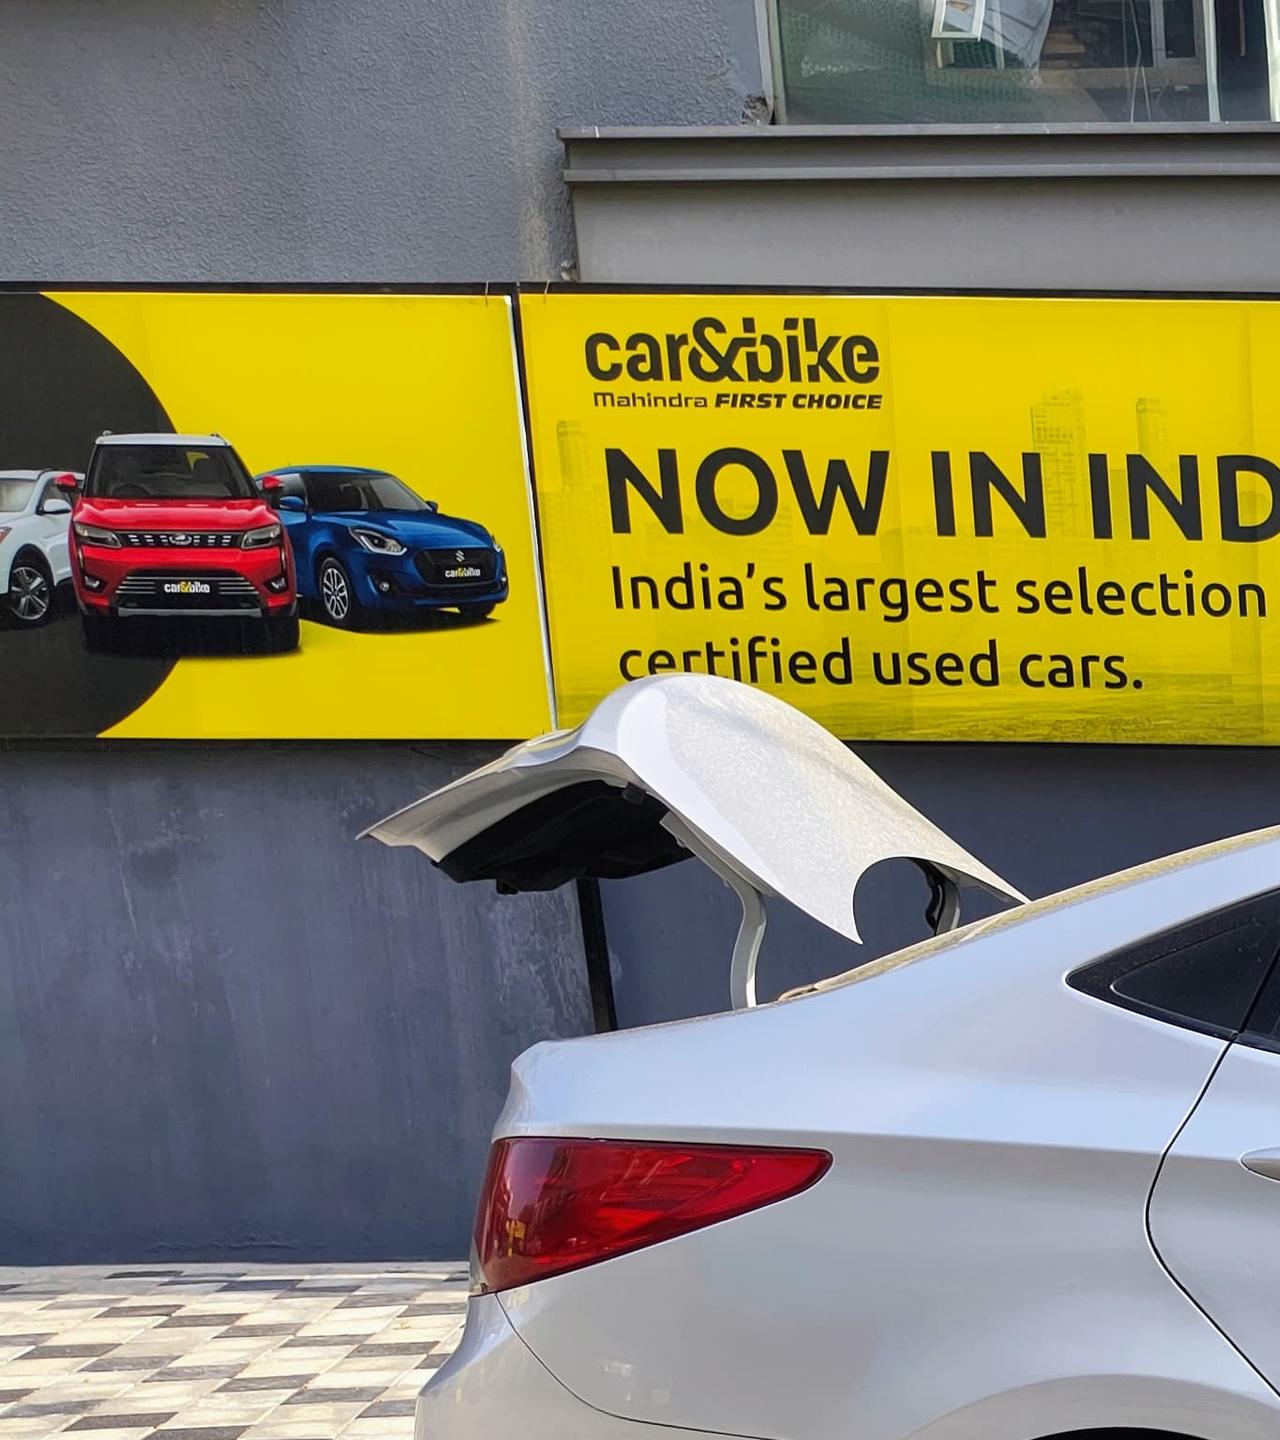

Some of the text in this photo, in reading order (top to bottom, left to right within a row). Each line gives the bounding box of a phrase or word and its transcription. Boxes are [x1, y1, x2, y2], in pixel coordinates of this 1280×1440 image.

[585, 317, 880, 384] car&bike
[593, 392, 883, 410] Mahindra FIRST CHOICE
[606, 448, 891, 538] NOW
[931, 451, 1048, 540] IN
[612, 562, 787, 612] India’s
[805, 563, 1001, 624] largest
[1016, 566, 1267, 619] selection
[619, 636, 1144, 691] certified used cars.
